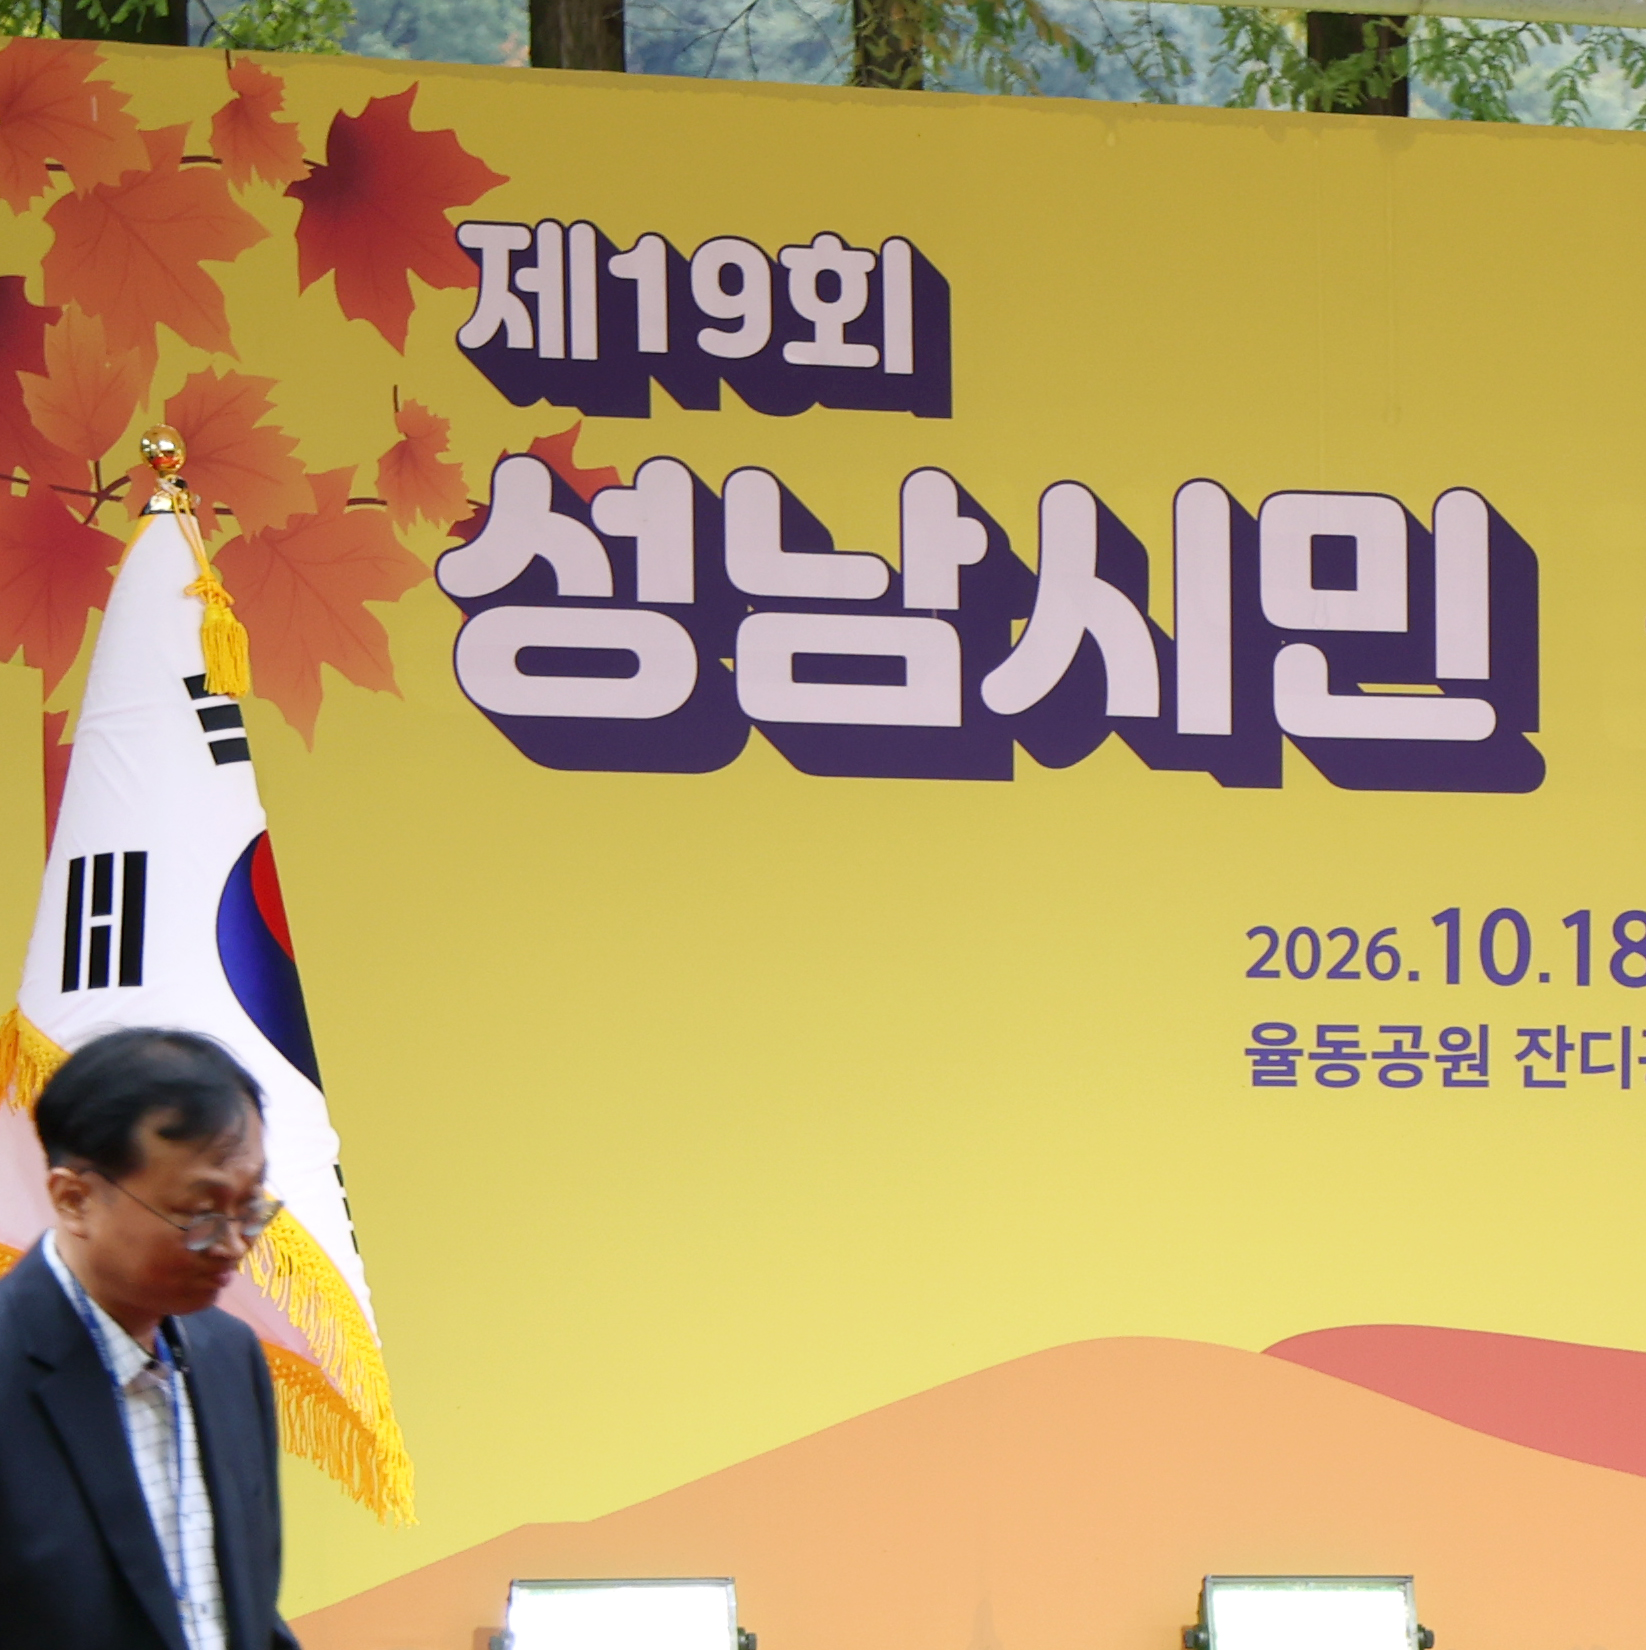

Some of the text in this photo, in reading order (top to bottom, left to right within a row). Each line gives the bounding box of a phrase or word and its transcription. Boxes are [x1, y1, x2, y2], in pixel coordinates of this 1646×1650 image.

[456, 218, 914, 375] 제19회
[435, 453, 1498, 741] 성남시민
[1243, 1021, 1490, 1089] 율동공원
